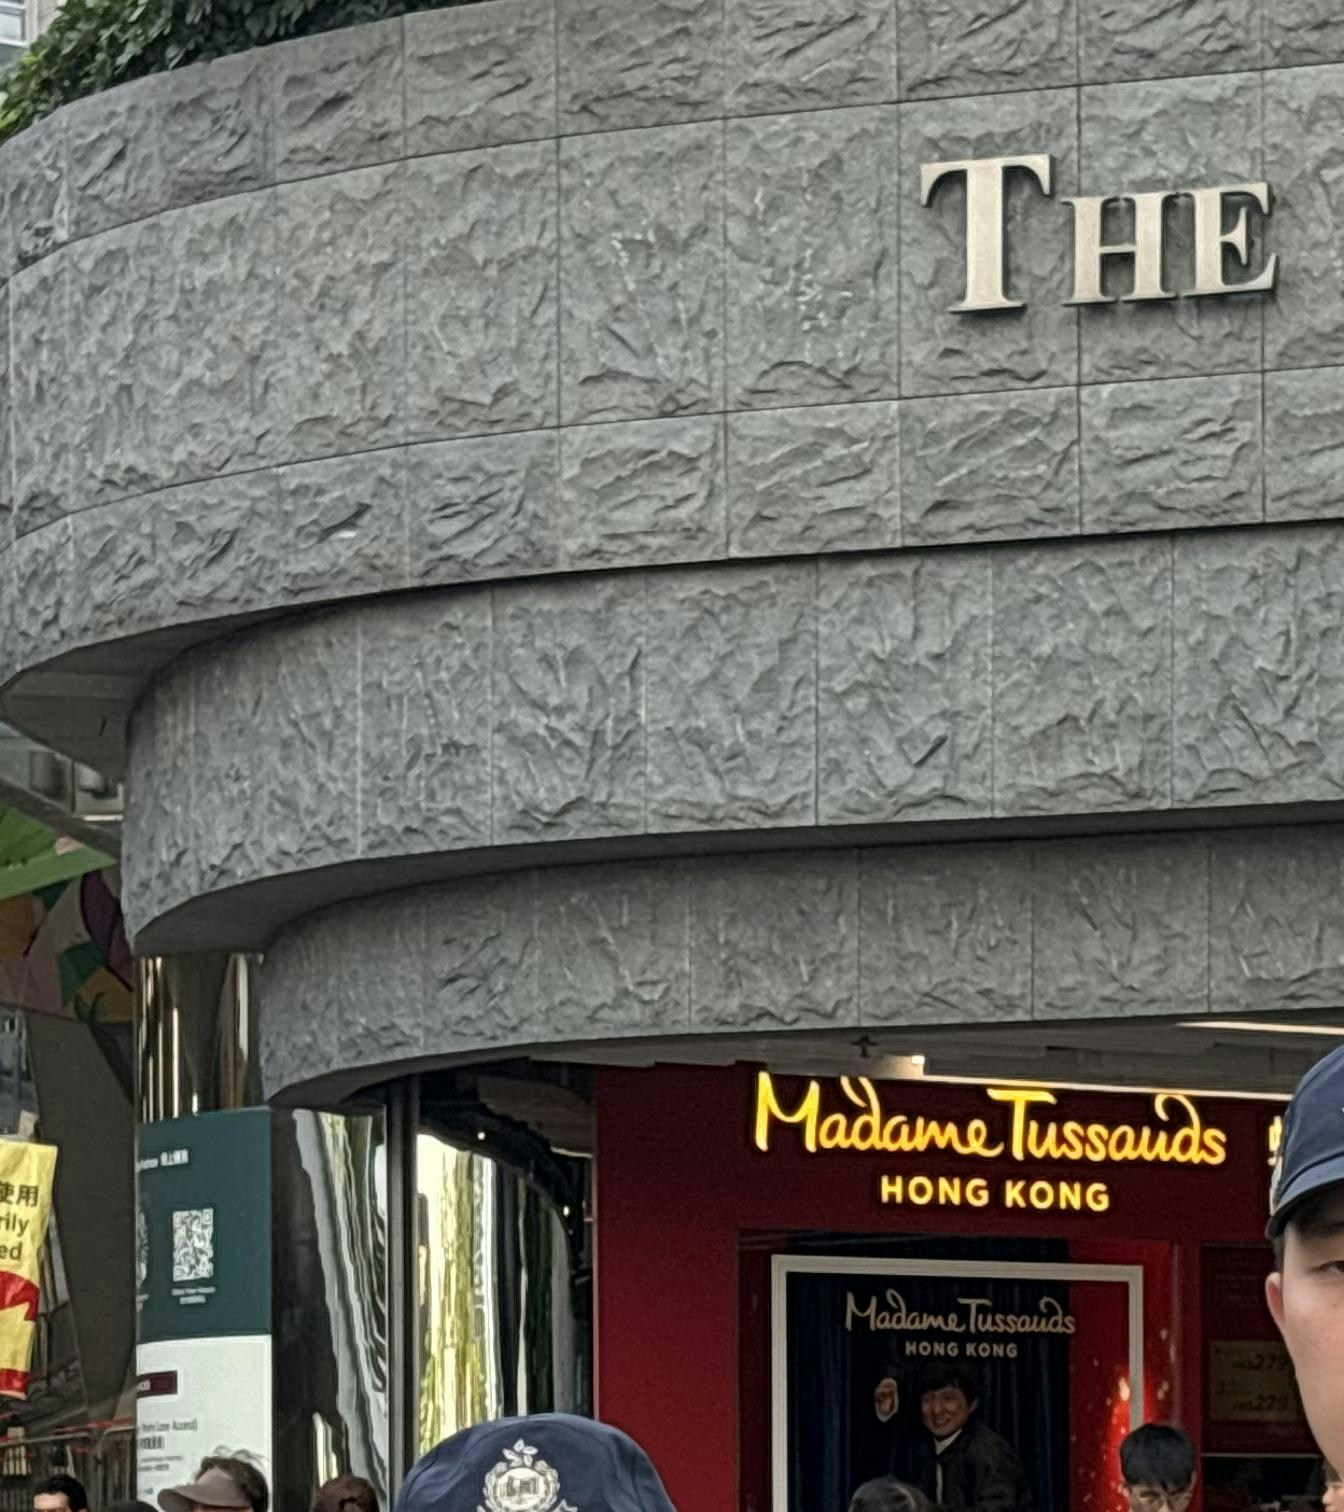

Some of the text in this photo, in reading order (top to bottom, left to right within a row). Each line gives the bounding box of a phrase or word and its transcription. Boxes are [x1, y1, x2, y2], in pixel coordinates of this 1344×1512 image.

[921, 153, 1277, 314] THE
[753, 1069, 1003, 1155] Madame
[987, 1085, 1227, 1165] Tussauds
[880, 1173, 1110, 1212] HONG KONG
[845, 1288, 1077, 1335] Madame Tussauds
[904, 1340, 1019, 1359] HONG KONG
